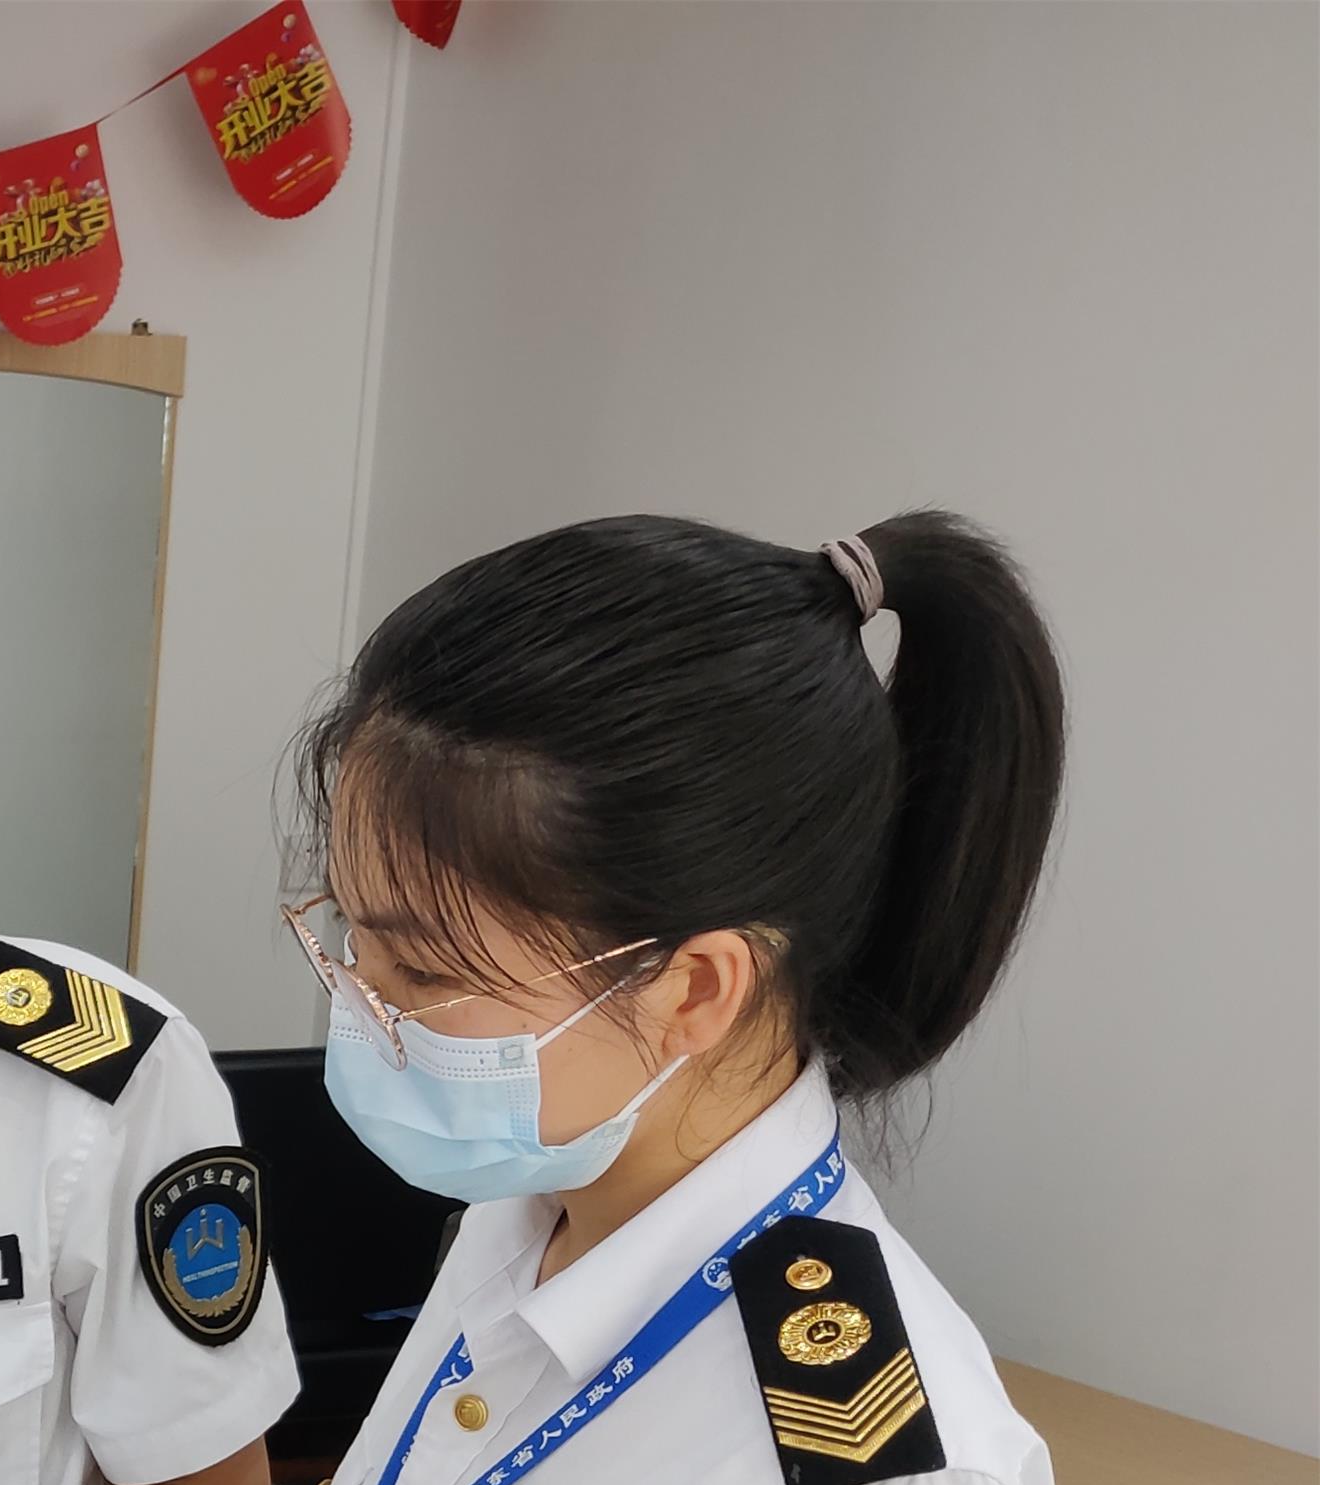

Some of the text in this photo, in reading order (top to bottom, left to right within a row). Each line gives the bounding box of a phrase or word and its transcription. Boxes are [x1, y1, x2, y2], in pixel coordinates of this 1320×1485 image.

[216, 58, 331, 160] 开业大吉
[154, 1168, 251, 1218] 中国卫生监督
